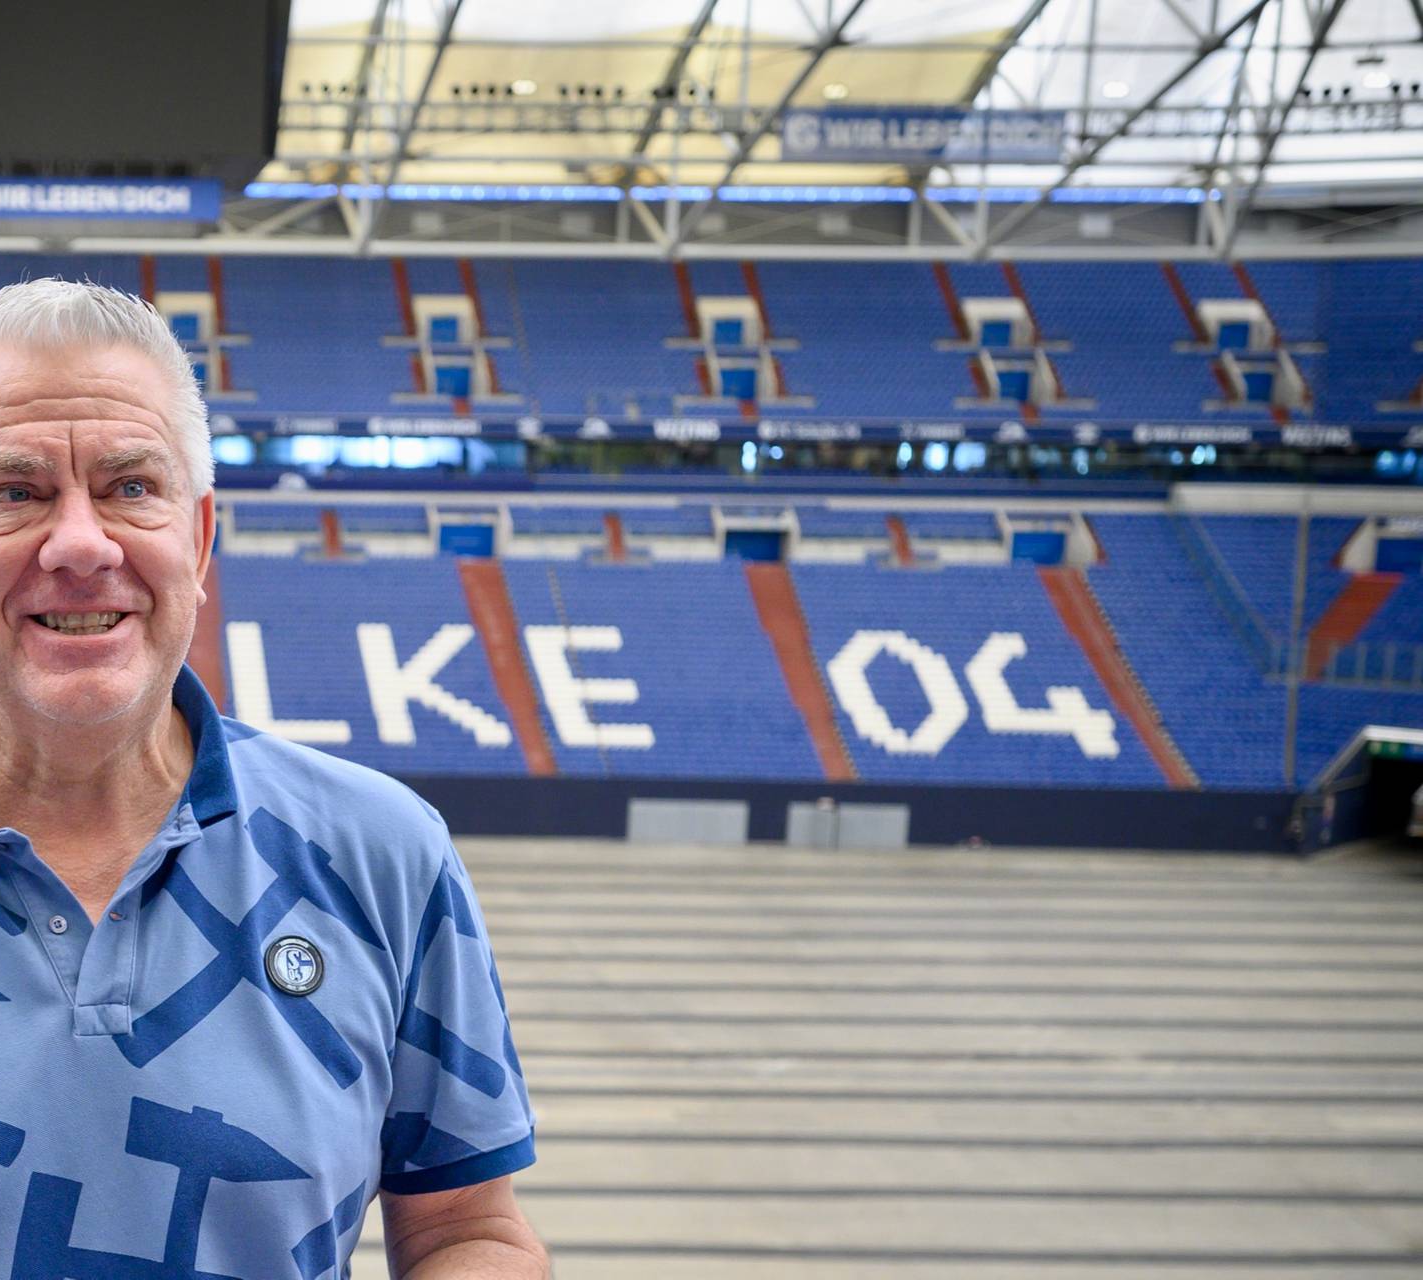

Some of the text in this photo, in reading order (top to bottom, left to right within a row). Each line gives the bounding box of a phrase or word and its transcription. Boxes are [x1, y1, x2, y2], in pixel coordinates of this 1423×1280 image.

[828, 118, 886, 149] WIR
[32, 183, 119, 212] LEBEN
[121, 184, 191, 213] DICH
[826, 629, 1121, 760] 04
